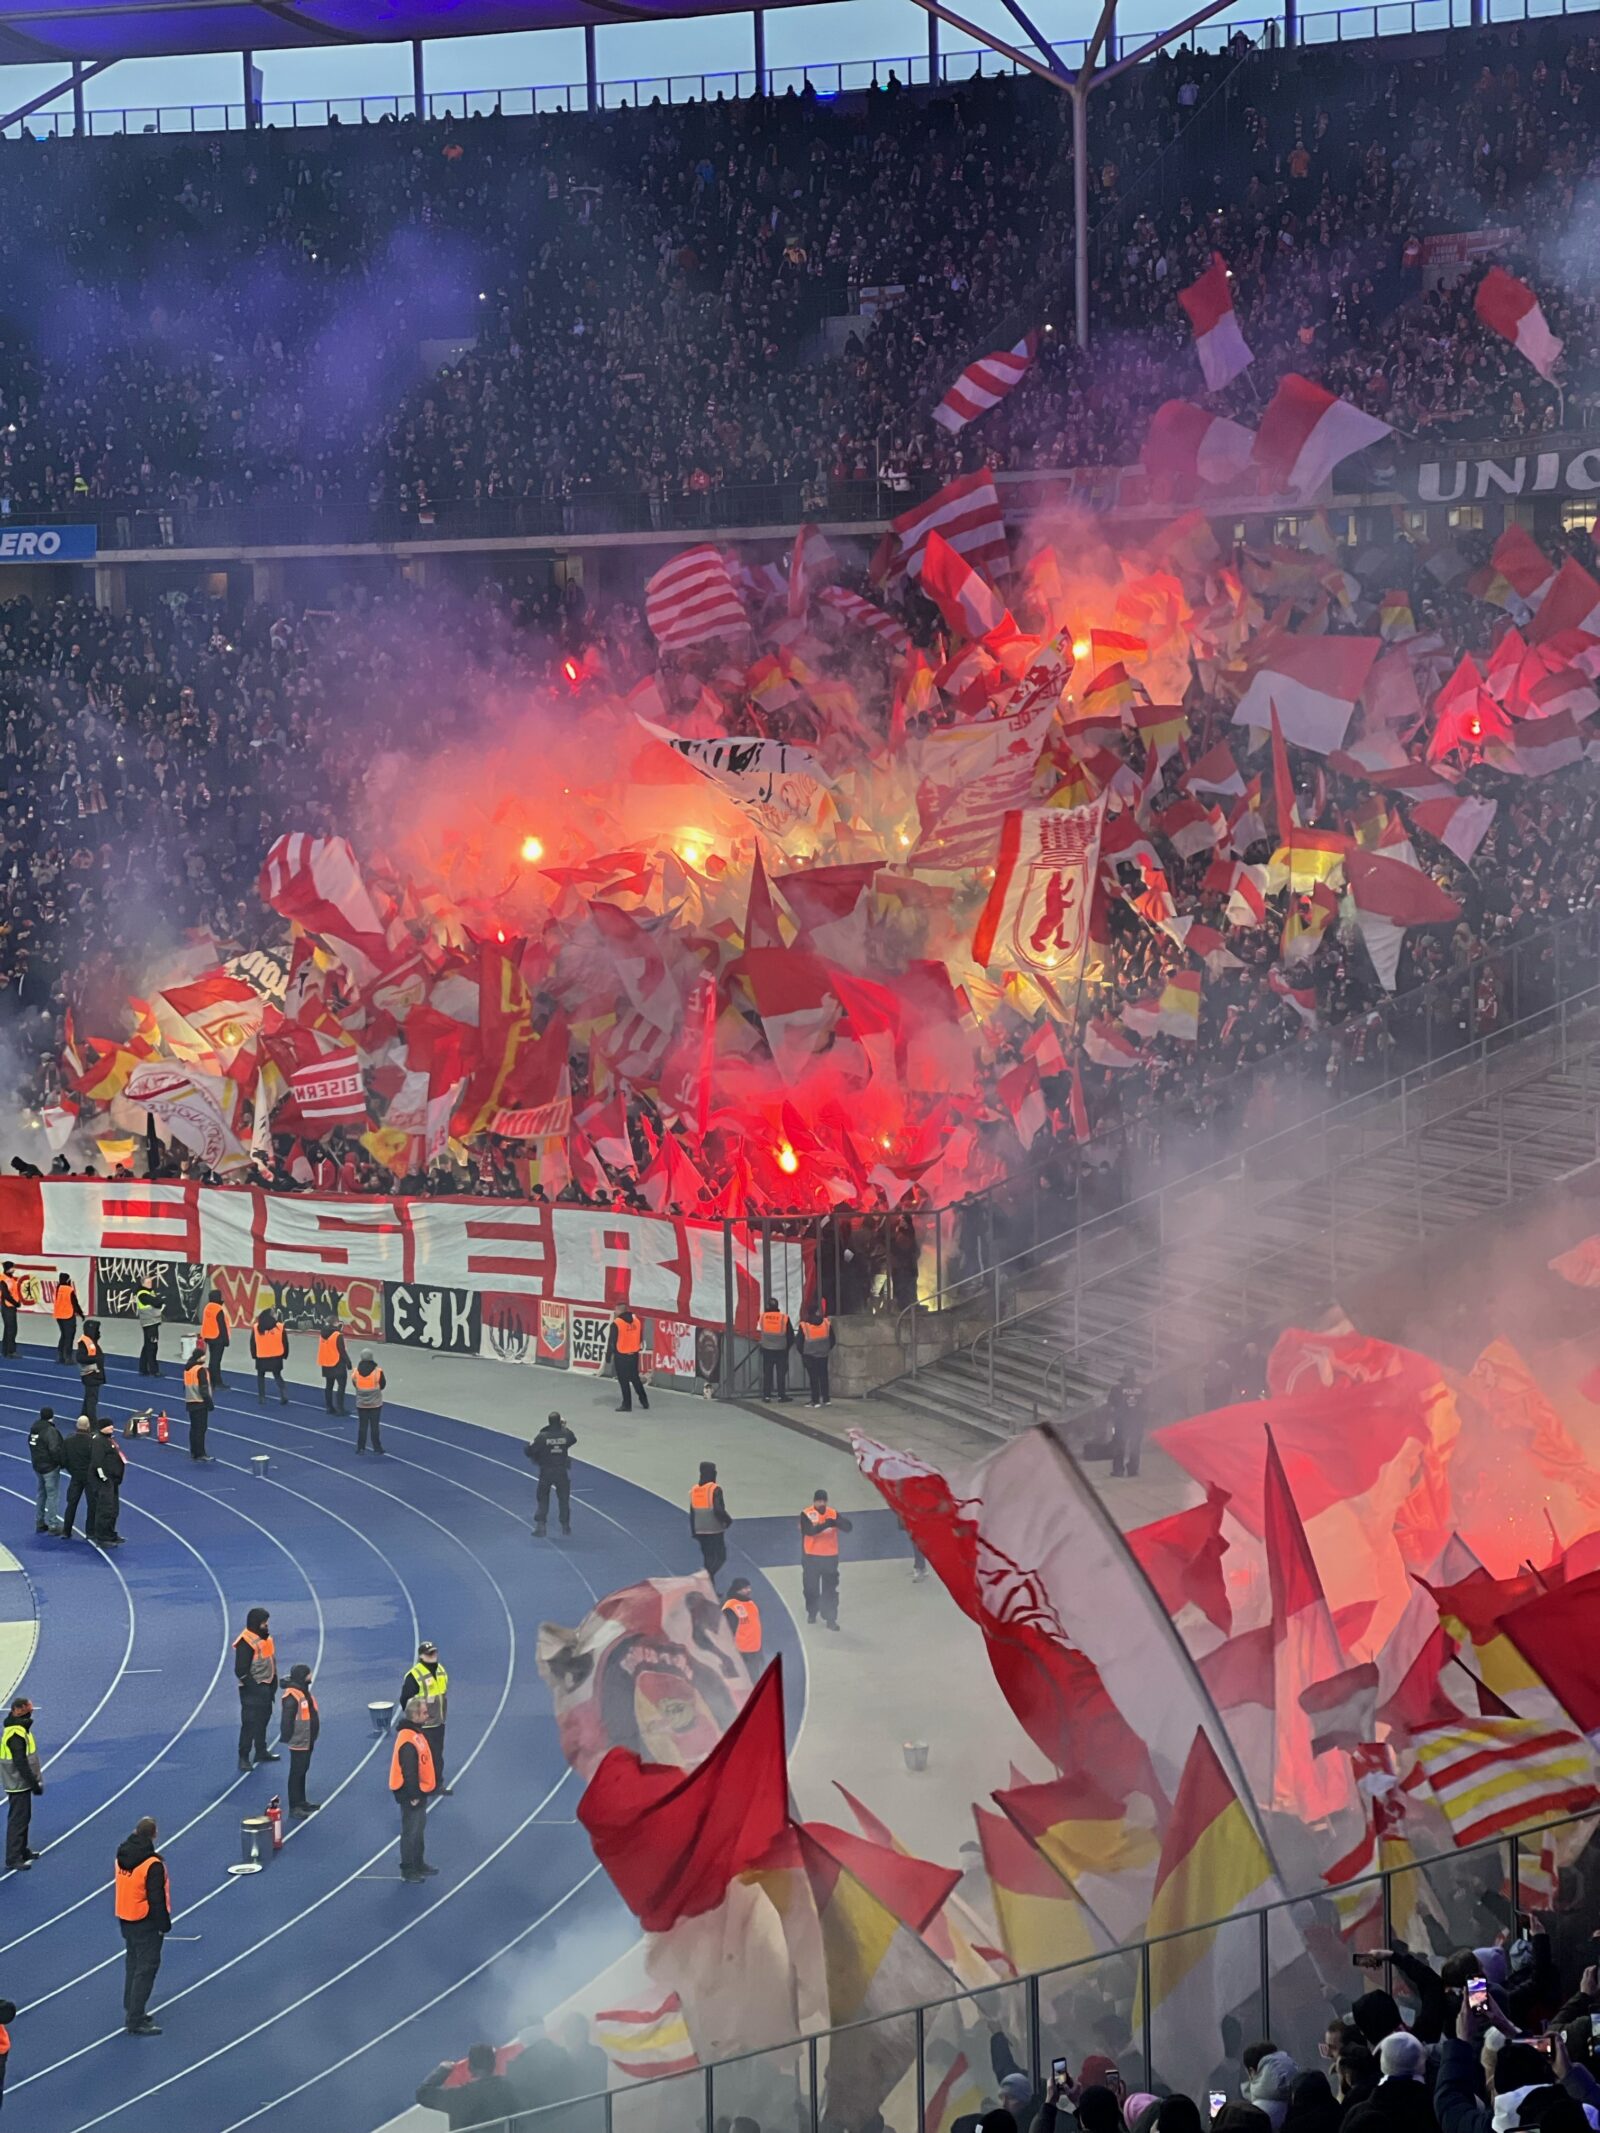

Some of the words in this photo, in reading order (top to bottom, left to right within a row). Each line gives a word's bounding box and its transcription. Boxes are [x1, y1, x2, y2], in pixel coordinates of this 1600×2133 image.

[0, 531, 61, 555] ERO
[40, 1181, 802, 1336] EISERN
[573, 1318, 609, 1343] SEK
